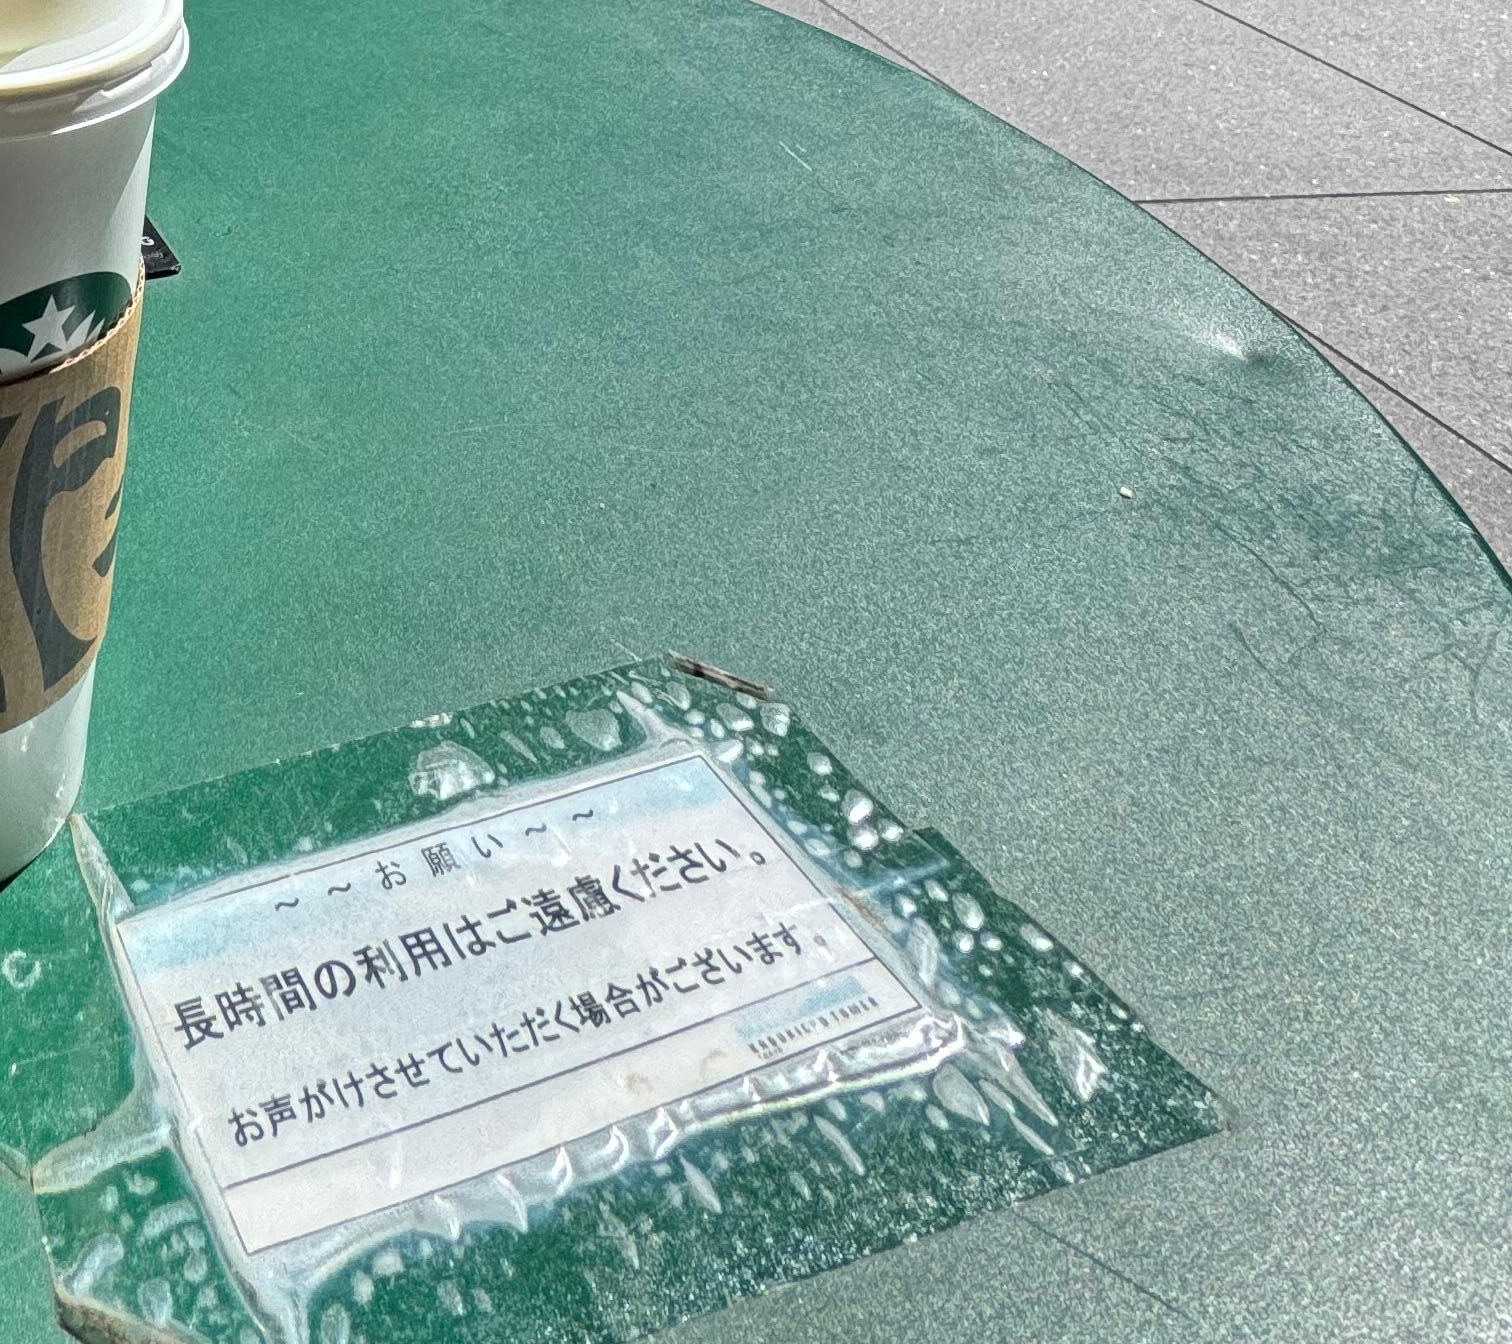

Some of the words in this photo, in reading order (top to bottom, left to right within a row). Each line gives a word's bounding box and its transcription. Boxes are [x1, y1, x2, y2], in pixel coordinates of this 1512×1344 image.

[173, 838, 767, 1050] 長時間の利用はご遠慮ください。
